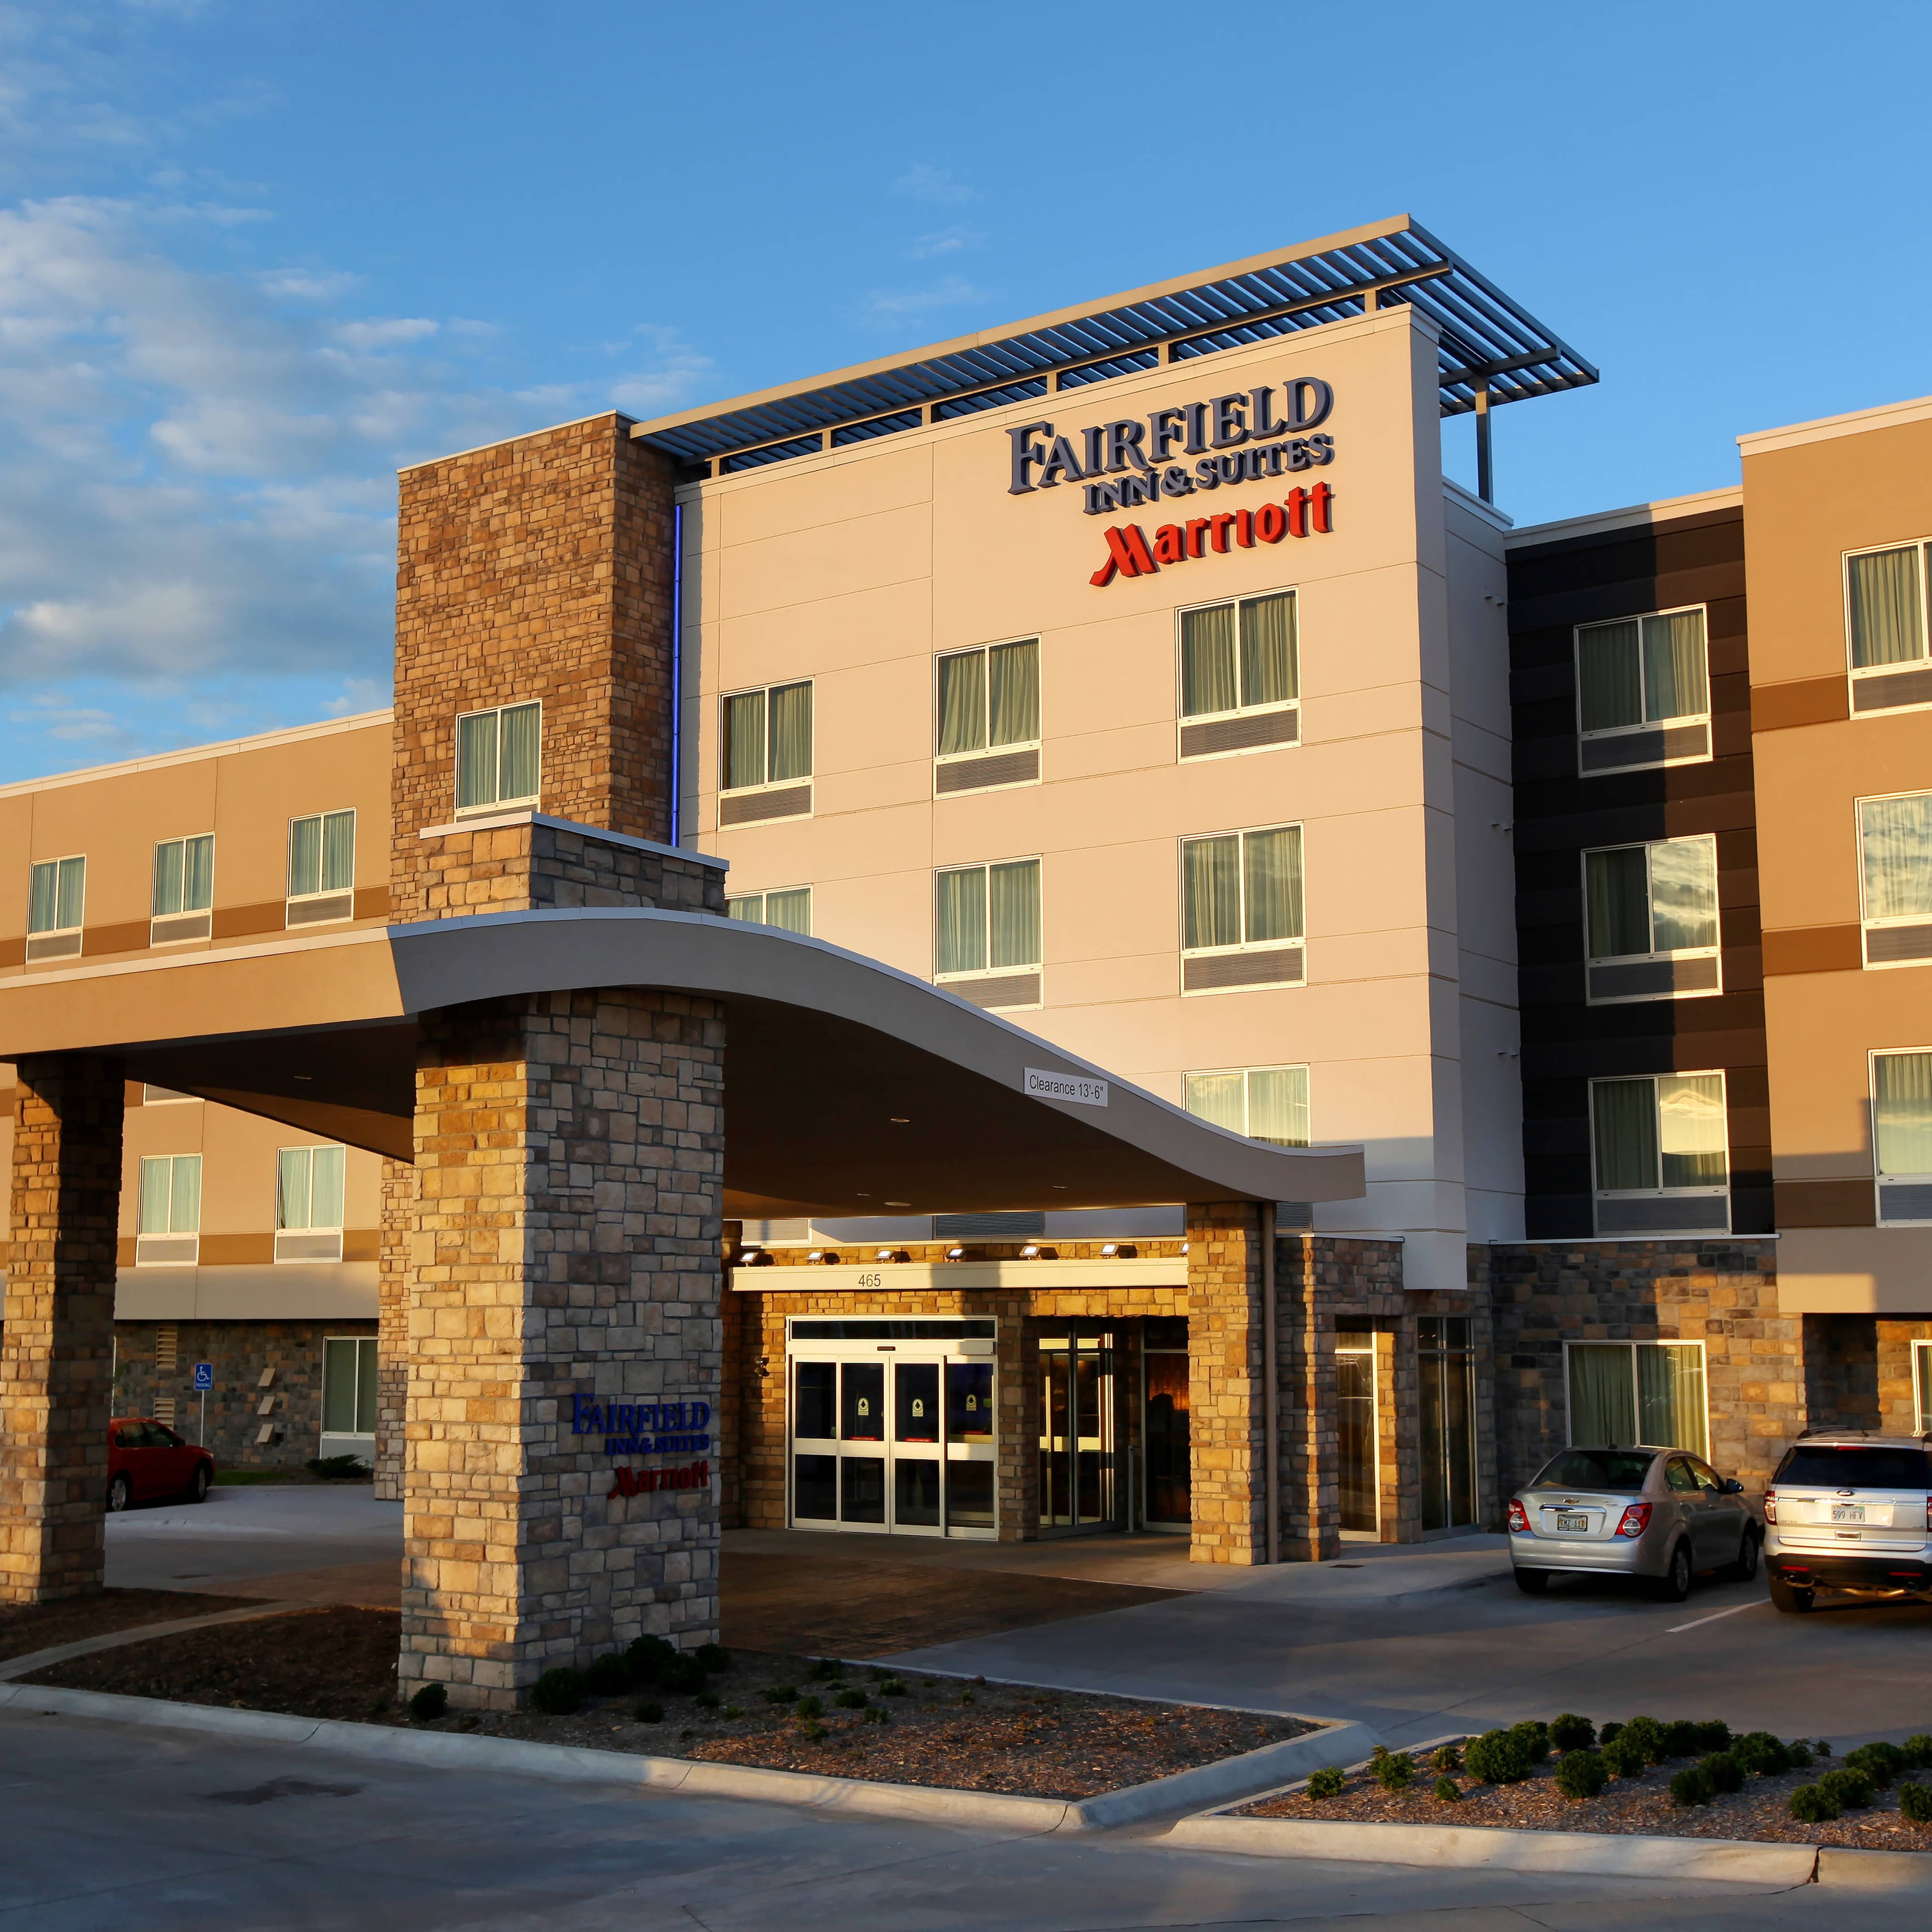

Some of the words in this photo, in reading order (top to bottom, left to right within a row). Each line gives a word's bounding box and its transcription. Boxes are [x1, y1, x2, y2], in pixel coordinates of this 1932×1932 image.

[1005, 376, 1335, 495] FAIRFIELD
[1082, 472, 1161, 515] INN
[1161, 466, 1197, 497] &
[1195, 433, 1335, 490] SUITES
[1089, 481, 1334, 587] Marriott
[1029, 1075, 1075, 1095] Clearance
[1079, 1083, 1103, 1099] 13'-6"
[858, 1274, 881, 1287] 465
[572, 1393, 711, 1435] FAIRFIELD
[605, 1437, 639, 1456] INN
[639, 1437, 655, 1454] &
[654, 1434, 710, 1454] SUITES
[607, 1460, 709, 1500] Marriott
[1832, 1510, 1846, 1519] 599
[1849, 1510, 1863, 1519] HFV
